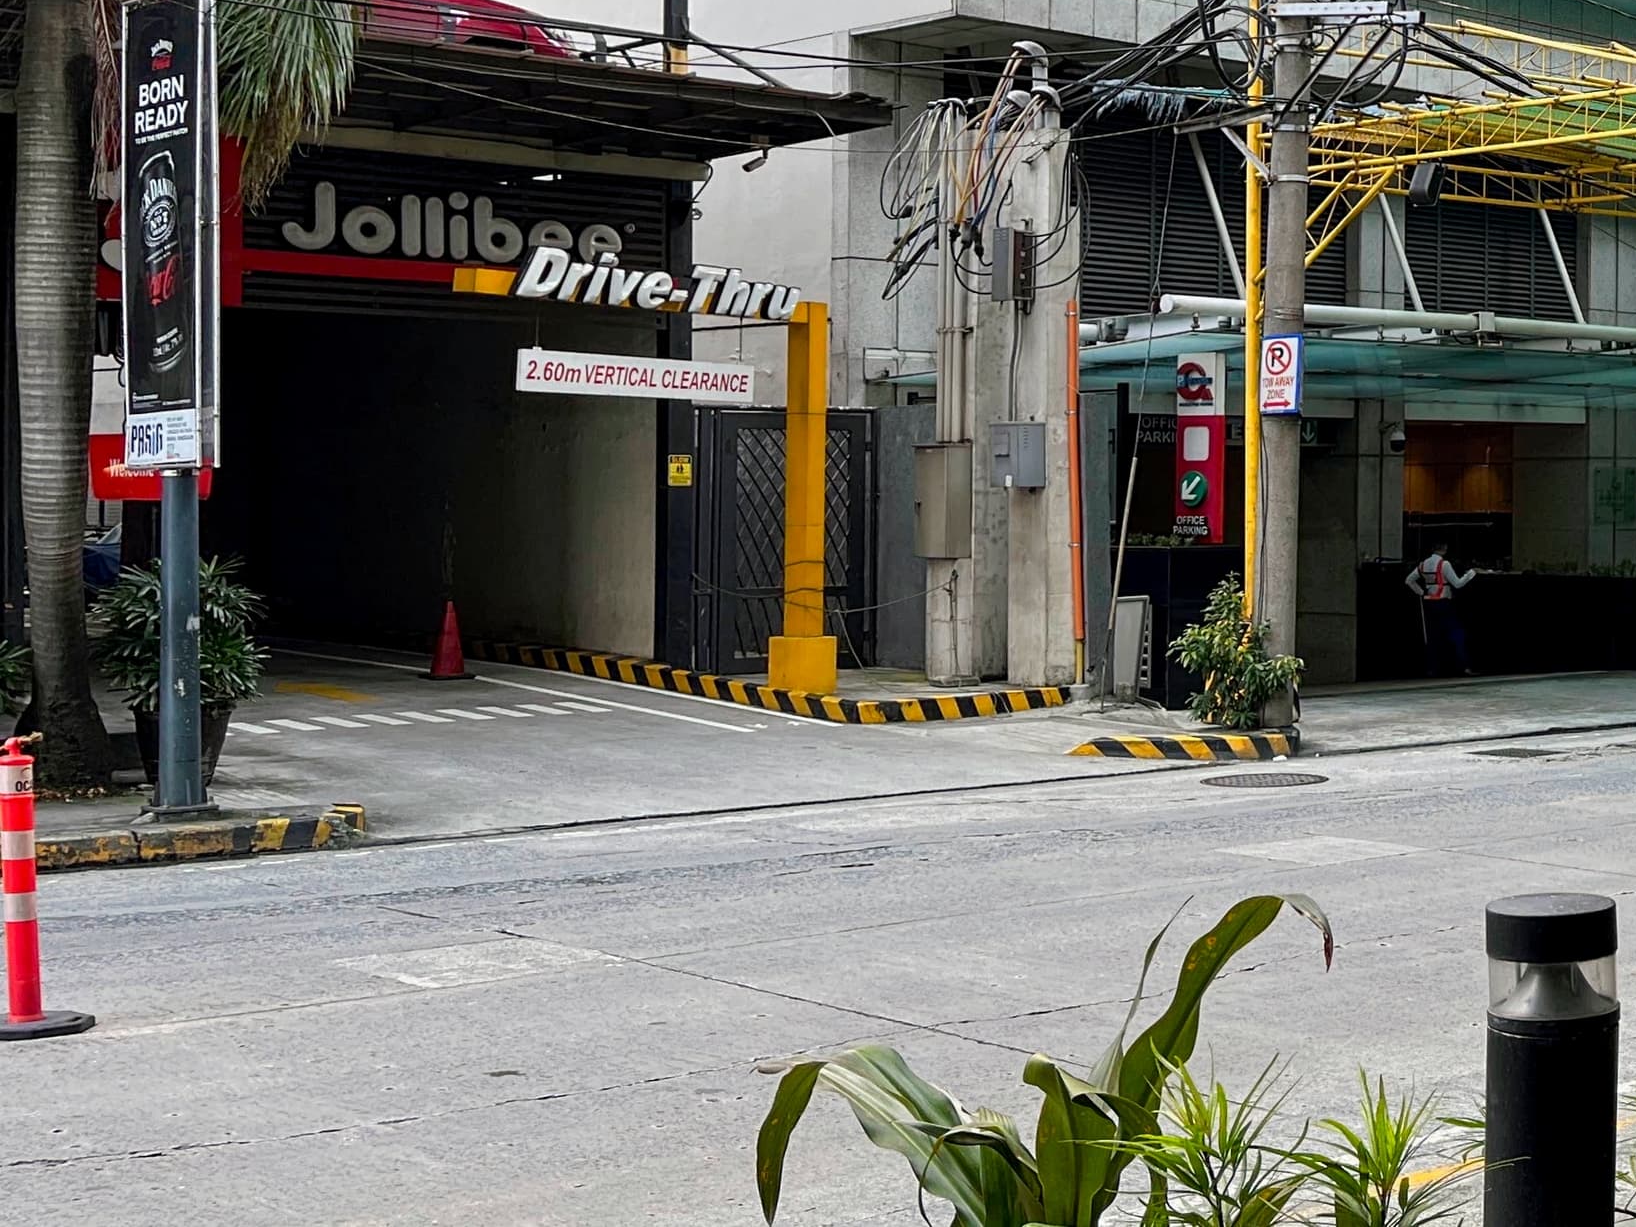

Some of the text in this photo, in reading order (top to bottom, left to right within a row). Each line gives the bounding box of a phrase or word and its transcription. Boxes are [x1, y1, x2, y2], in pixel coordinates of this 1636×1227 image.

[138, 74, 185, 107] BORN
[134, 100, 189, 134] READY
[282, 181, 622, 267] Jollibee
[515, 245, 801, 321] Drive-Thru
[526, 360, 749, 393] 2.60m VERTICAL CLEARANCE
[1275, 376, 1295, 386] AWAY
[1267, 389, 1285, 399] ZONE
[1142, 416, 1177, 429] OFFIC
[1138, 431, 1177, 443] PARKI
[1176, 515, 1206, 524] OFFICE
[1172, 525, 1209, 535] PARKING
